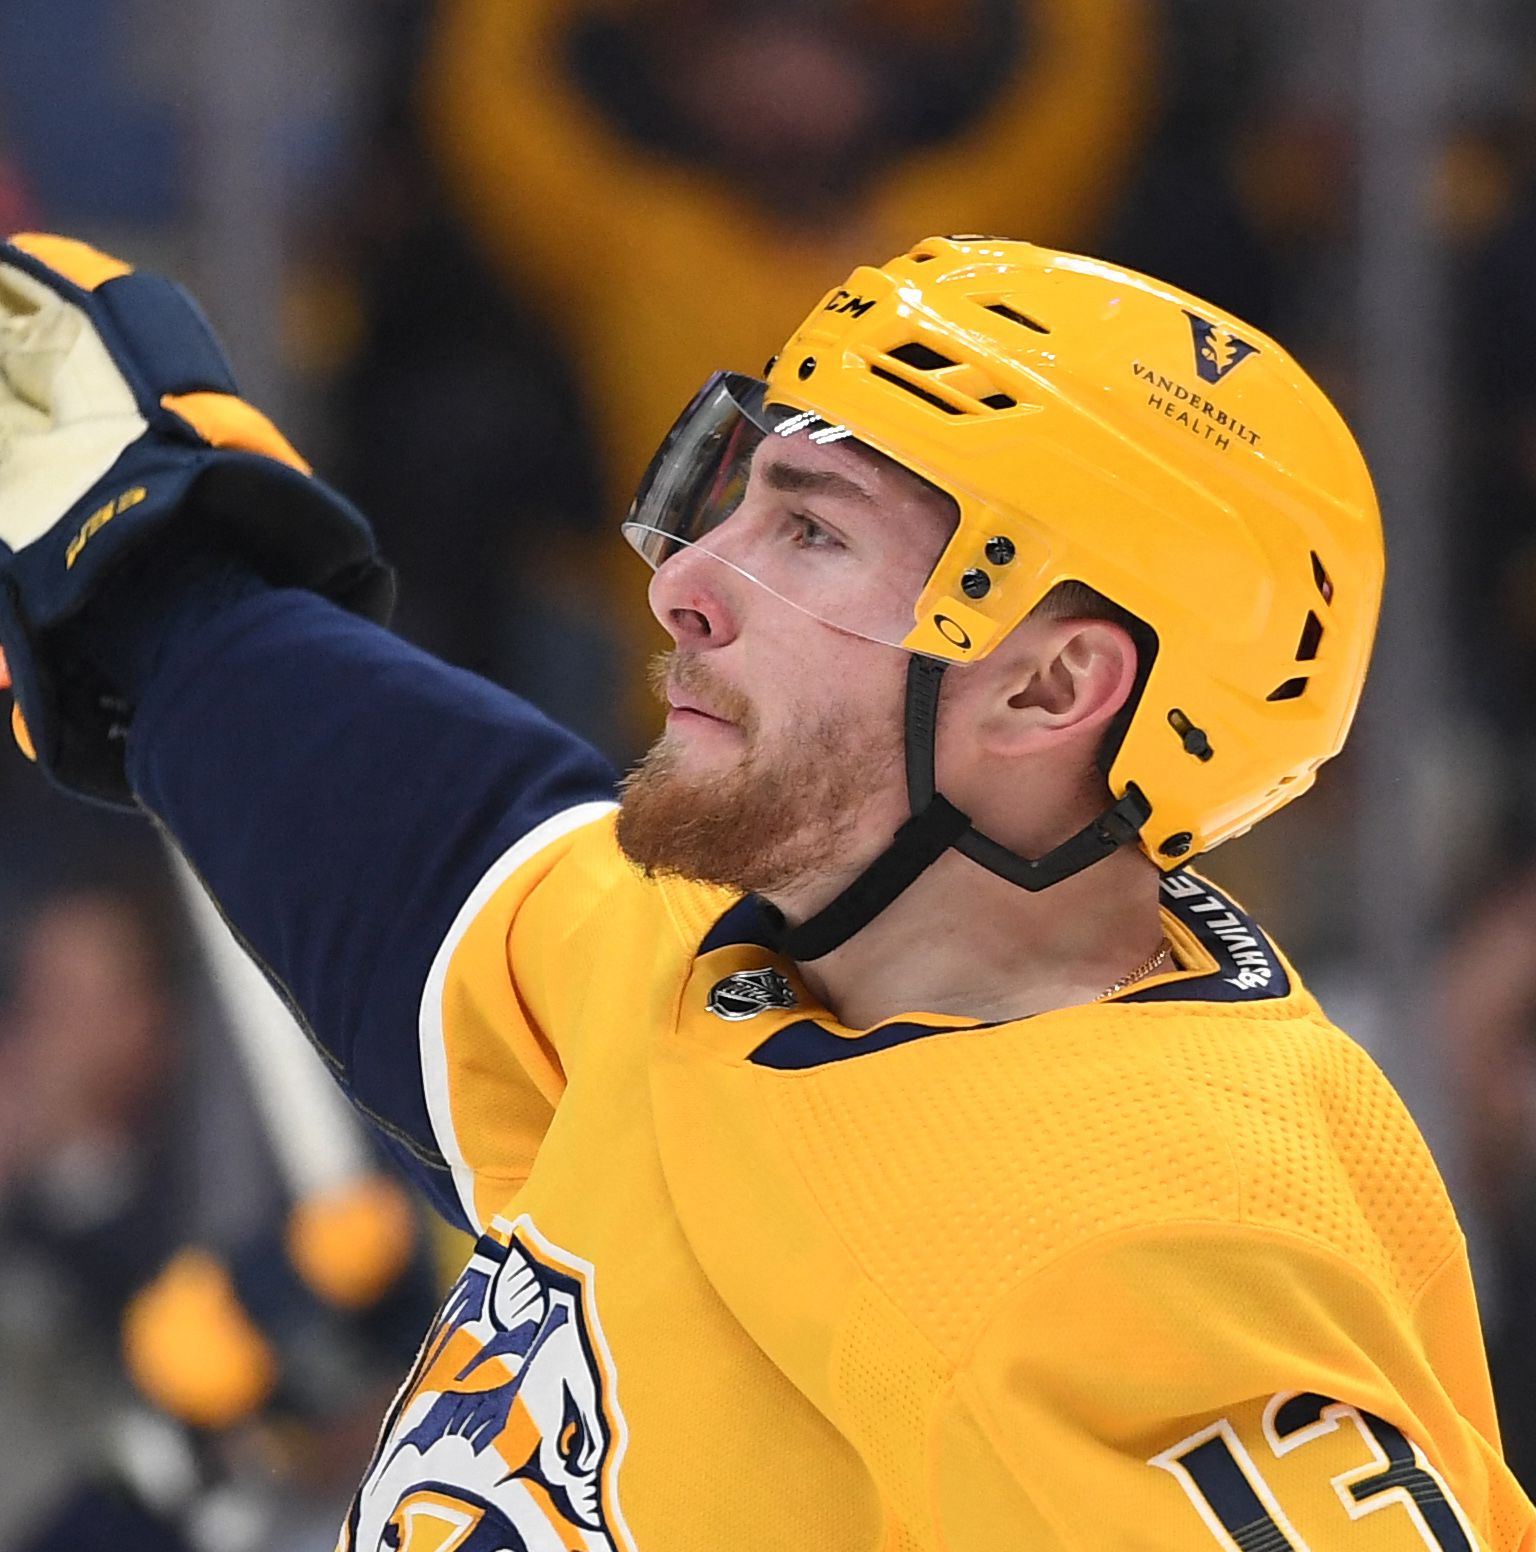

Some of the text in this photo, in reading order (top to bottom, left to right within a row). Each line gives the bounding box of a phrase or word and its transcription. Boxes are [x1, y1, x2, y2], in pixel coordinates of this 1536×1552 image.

[823, 290, 877, 319] CM
[1132, 362, 1261, 446] VANDERBILT
[1147, 393, 1230, 451] HEALTH
